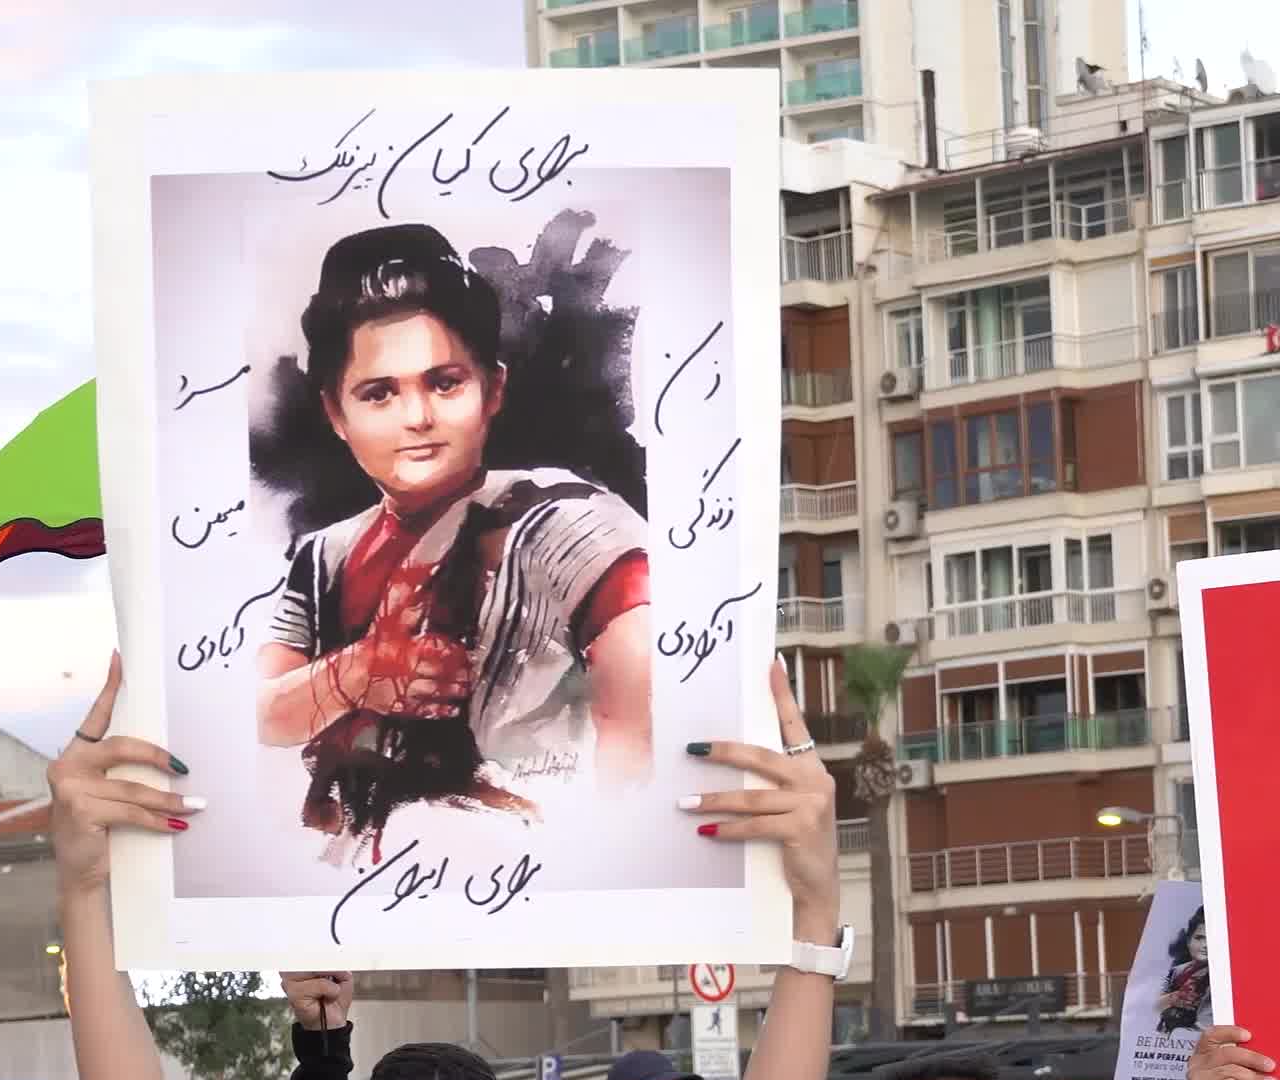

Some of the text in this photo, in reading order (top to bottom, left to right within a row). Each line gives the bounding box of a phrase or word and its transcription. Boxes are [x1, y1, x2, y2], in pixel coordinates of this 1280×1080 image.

[330, 839, 542, 945] برای ایران
[1136, 1035, 1152, 1047] BE
[1134, 1051, 1155, 1060] KIAN
[1144, 1062, 1167, 1072] years
[1169, 1063, 1184, 1072] old
